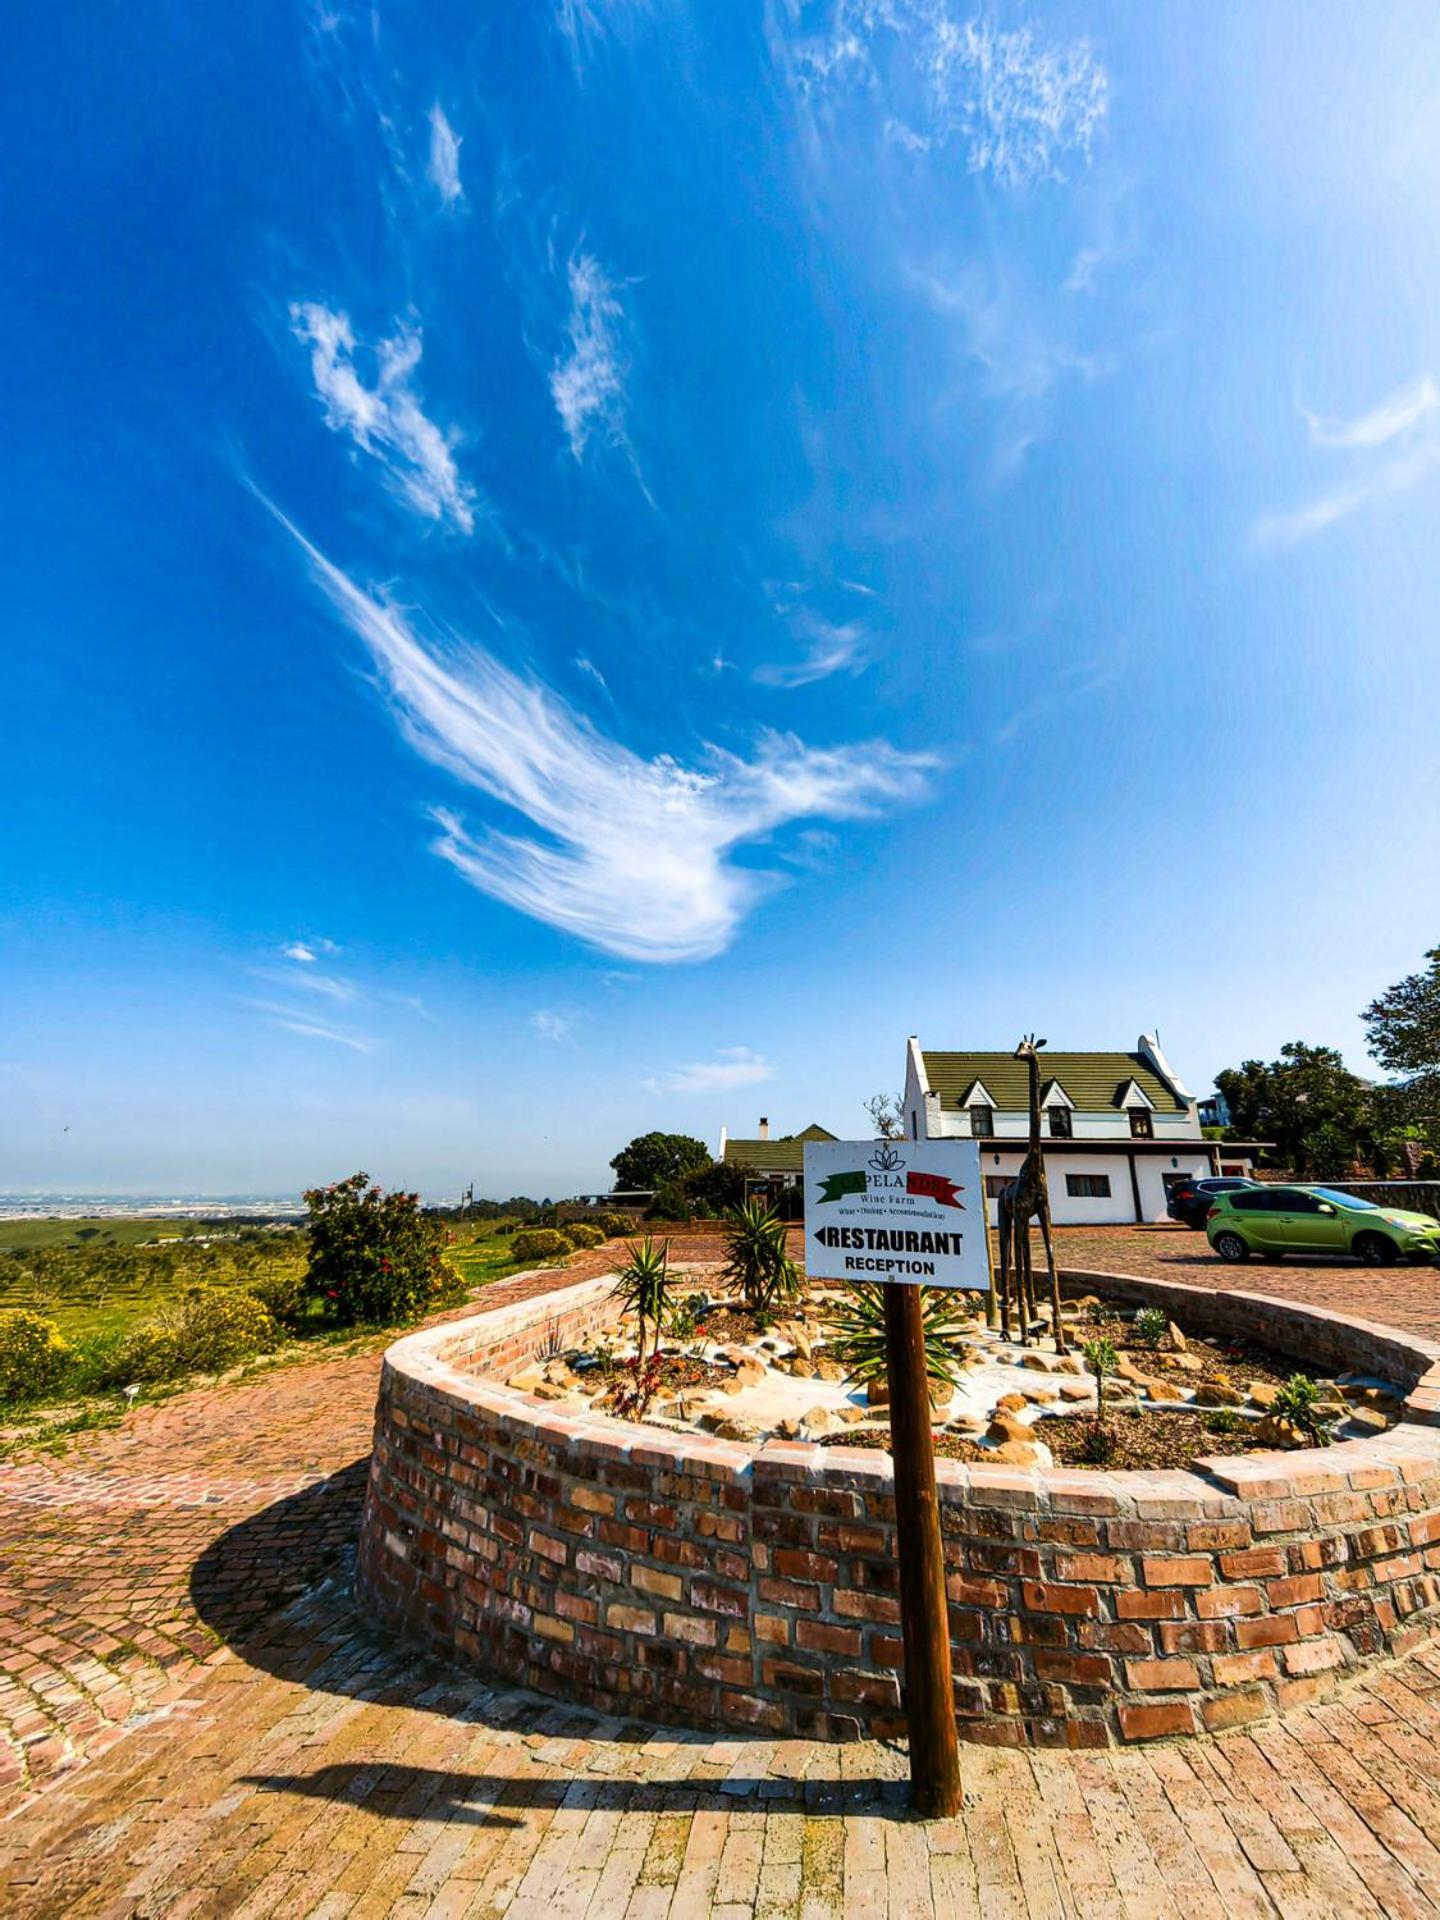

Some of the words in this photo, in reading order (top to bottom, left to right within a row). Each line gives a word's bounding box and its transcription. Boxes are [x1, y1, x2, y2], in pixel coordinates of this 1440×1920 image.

[841, 1174, 942, 1191] CAPELANDS
[860, 1194, 885, 1204] Wine
[889, 1195, 915, 1205] Farm
[889, 1208, 945, 1220] Accommodation
[827, 1226, 963, 1255] RESTAURANT
[845, 1256, 935, 1275] RECEPTION
